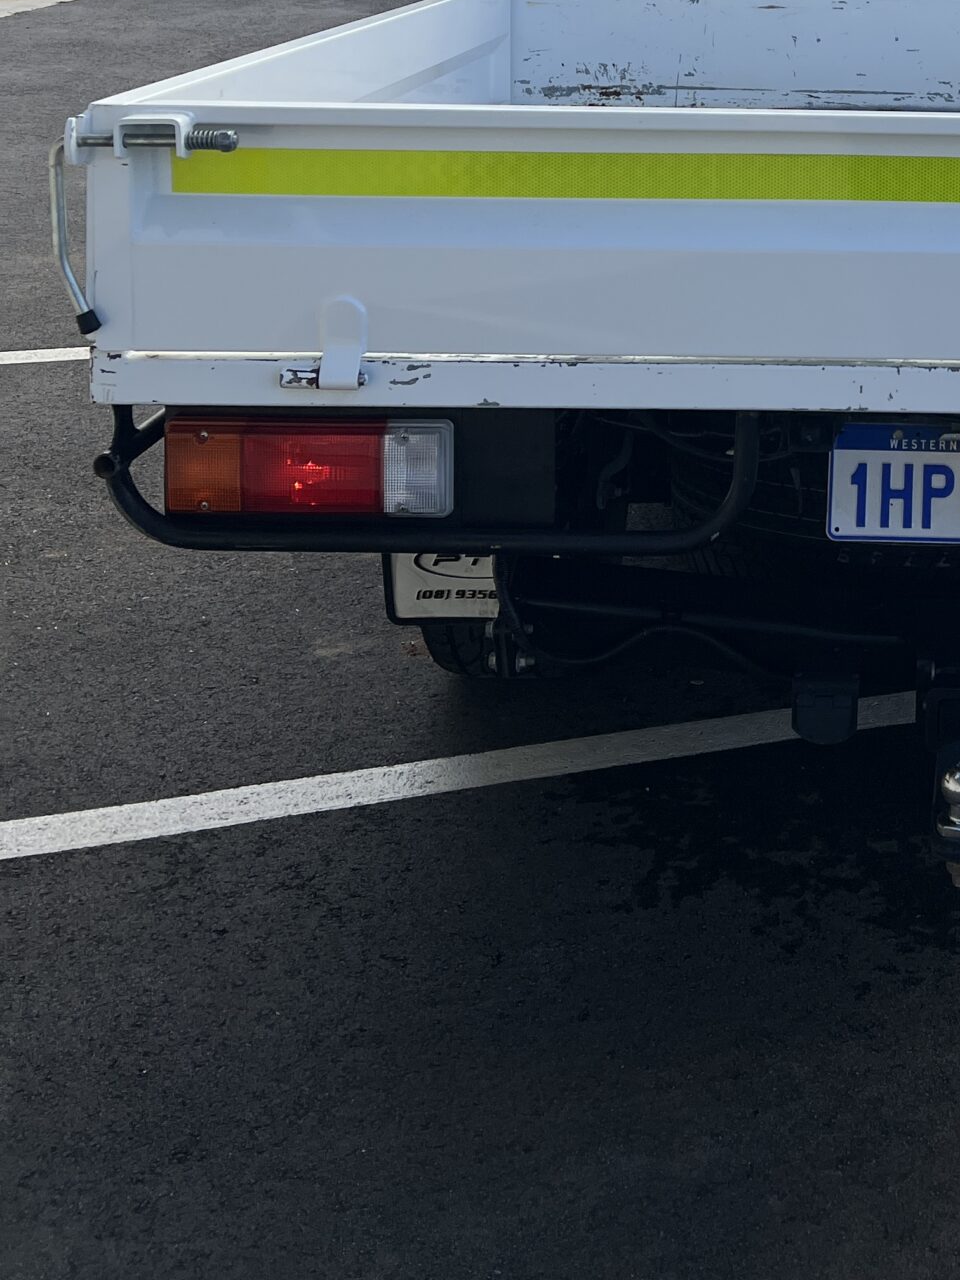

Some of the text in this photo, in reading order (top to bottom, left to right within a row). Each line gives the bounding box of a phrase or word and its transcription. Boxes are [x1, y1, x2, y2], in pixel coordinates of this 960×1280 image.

[889, 438, 957, 450] WESTERN
[432, 554, 493, 567] PT
[416, 589, 498, 601] (08) 9356
